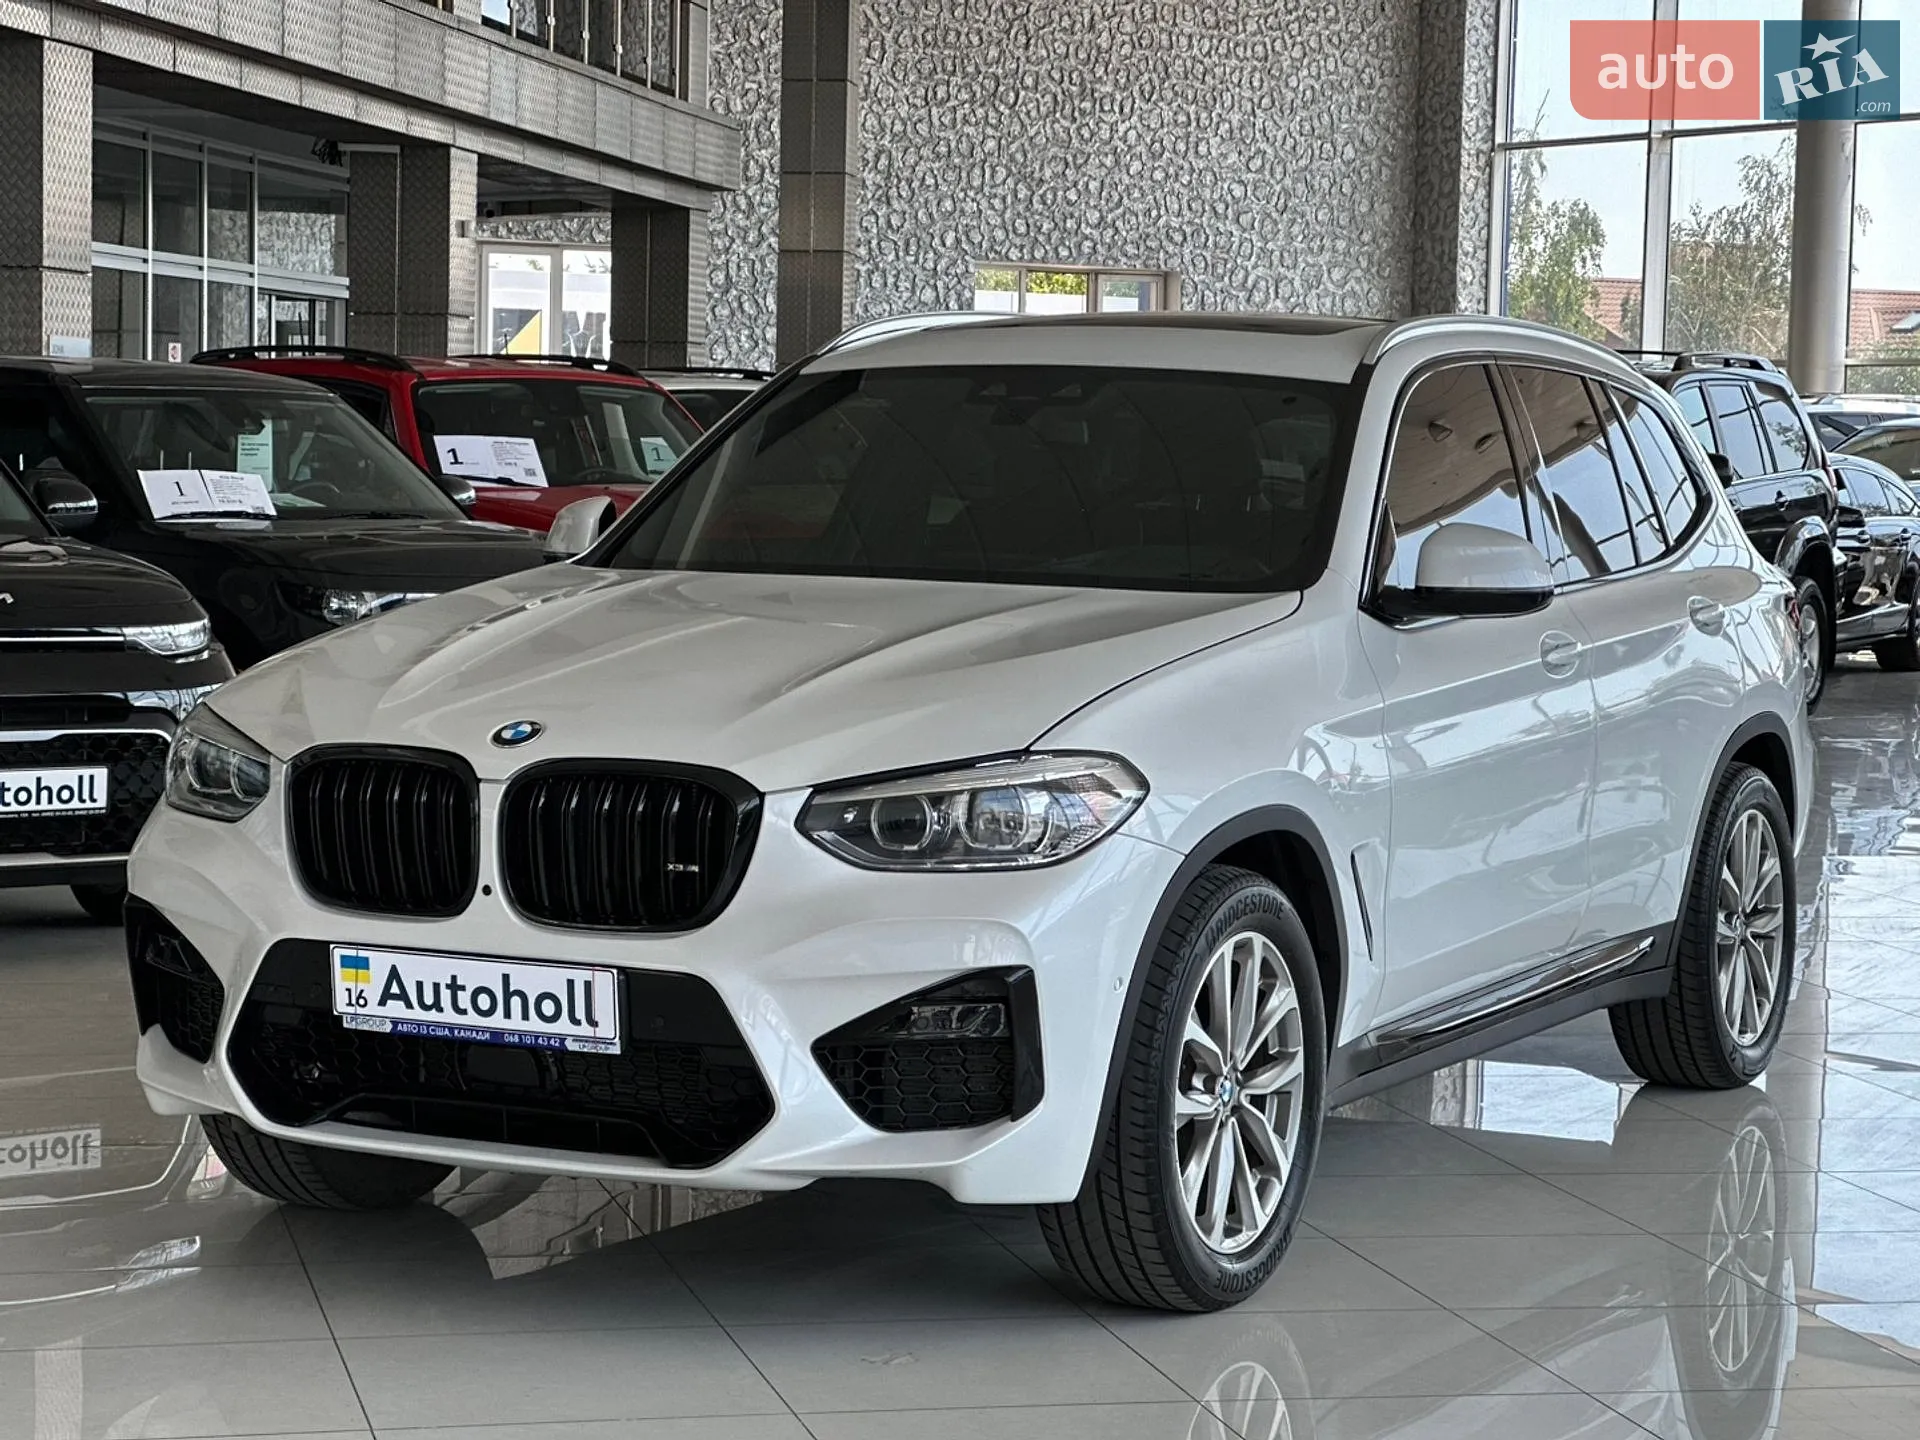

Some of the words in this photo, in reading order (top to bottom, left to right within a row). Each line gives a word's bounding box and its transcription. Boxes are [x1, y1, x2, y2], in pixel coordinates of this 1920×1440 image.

[447, 448, 464, 465] 1
[173, 481, 185, 496] 1
[1205, 894, 1284, 953] BRIDGESTONE
[345, 987, 368, 1008] 16
[377, 964, 599, 1028] Autoholl
[397, 1022, 419, 1034] АВТО
[454, 1029, 490, 1040] КАНАДИ
[503, 1033, 519, 1043] 068
[521, 1035, 535, 1045] 101
[549, 1037, 560, 1047] 42
[1214, 1223, 1292, 1293] BRIDGESTONE
